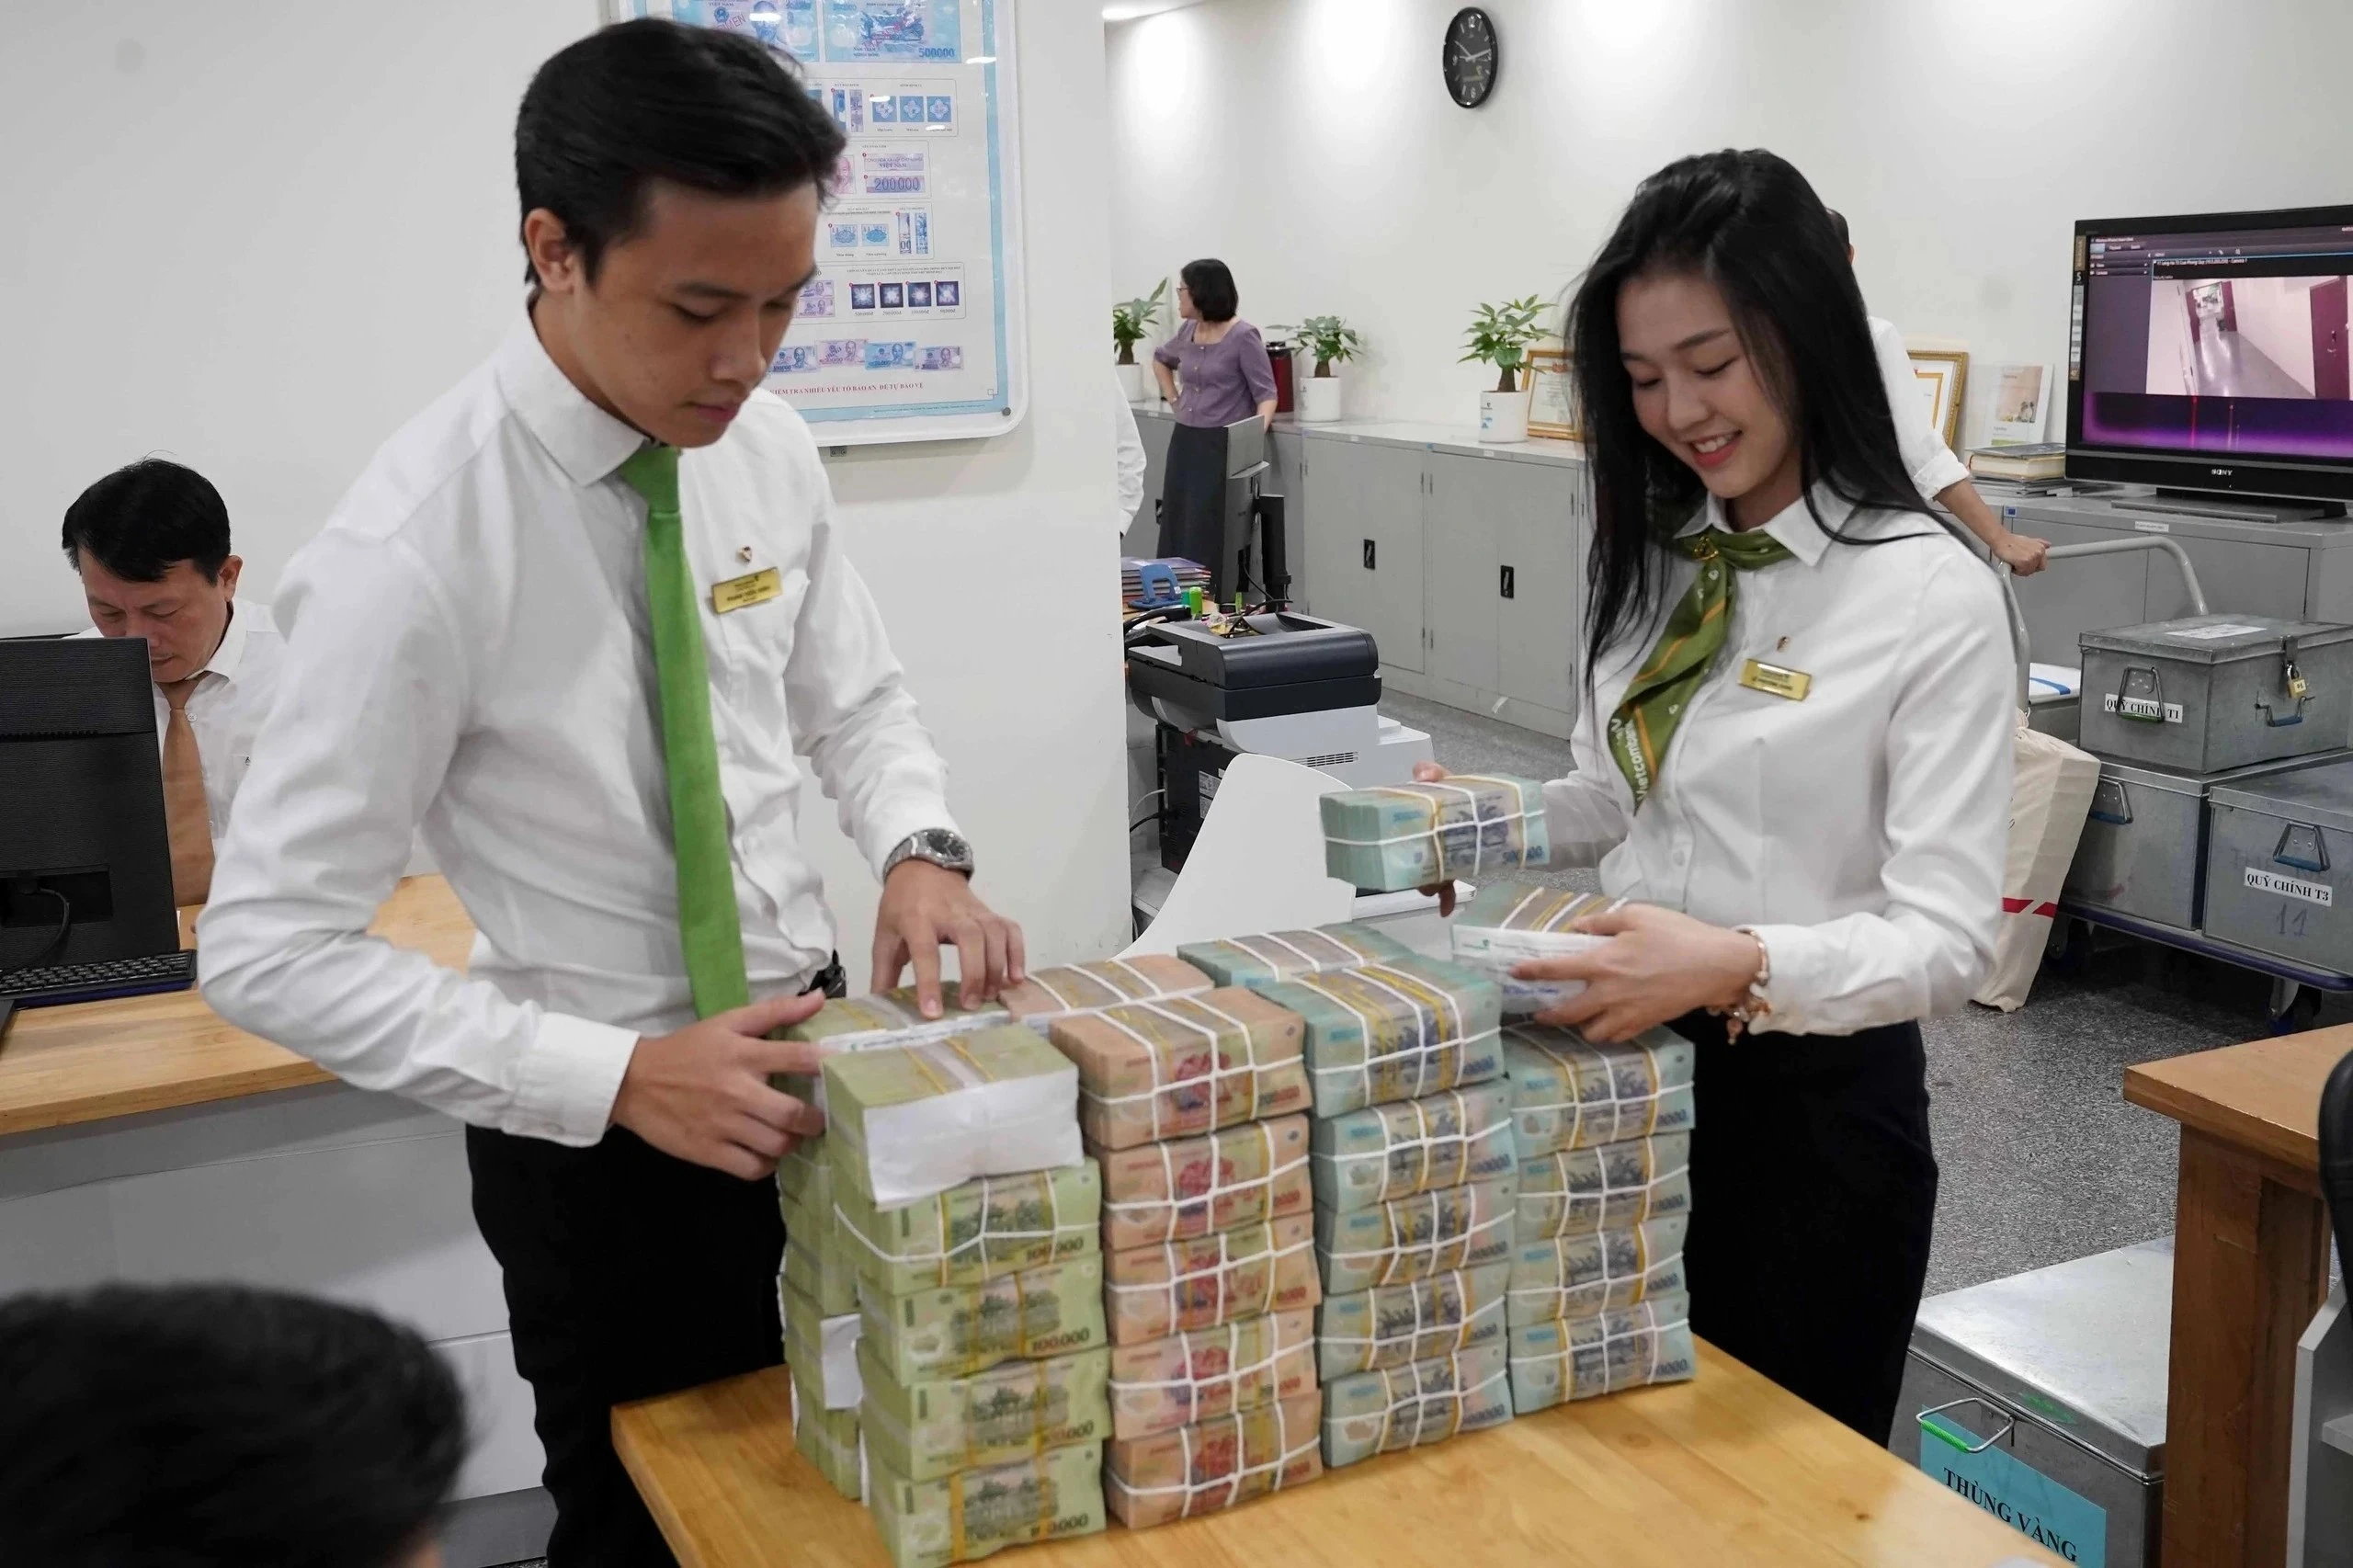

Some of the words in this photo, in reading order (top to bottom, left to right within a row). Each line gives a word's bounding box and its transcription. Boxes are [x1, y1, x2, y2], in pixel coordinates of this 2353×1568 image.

[918, 47, 955, 58] 500000
[2211, 468, 2233, 476] SONY
[2247, 873, 2271, 887] QUỸ
[2274, 880, 2312, 898] CHÍNH
[2314, 889, 2329, 902] T3
[1943, 1467, 2012, 1524] THÙNG
[2017, 1511, 2078, 1562] VÀNG
